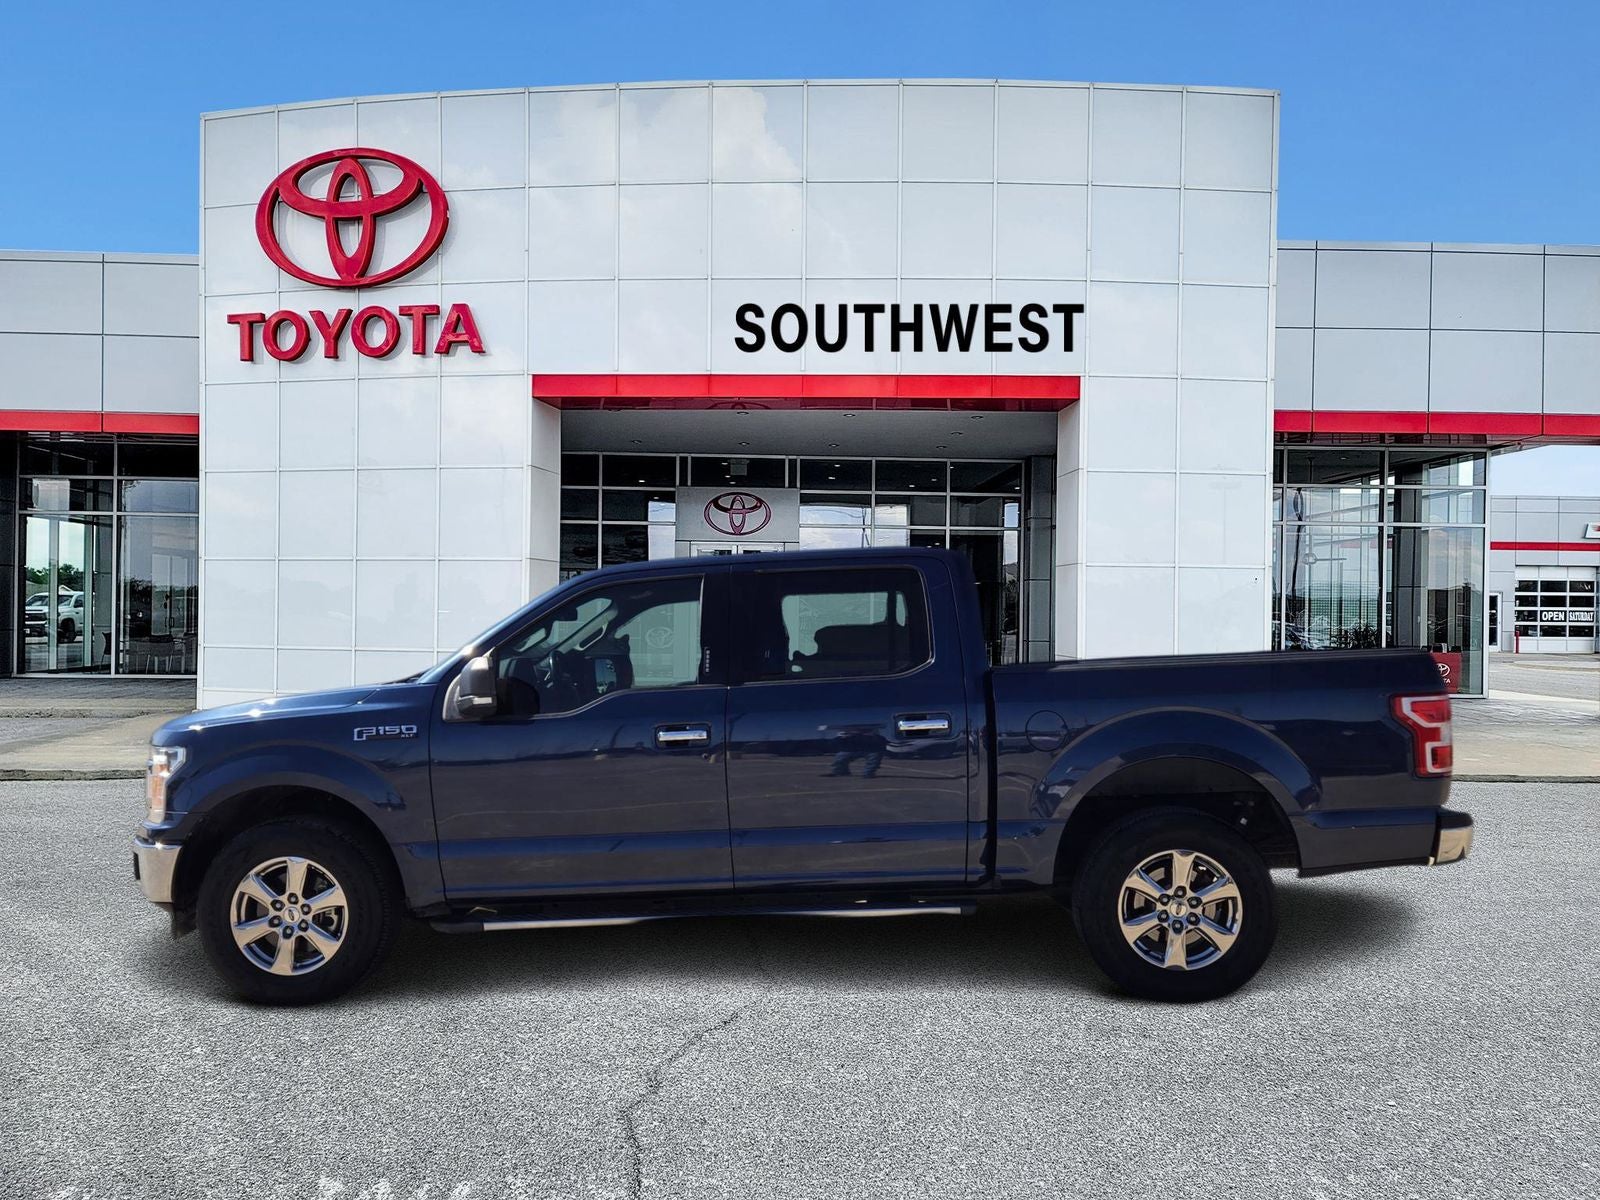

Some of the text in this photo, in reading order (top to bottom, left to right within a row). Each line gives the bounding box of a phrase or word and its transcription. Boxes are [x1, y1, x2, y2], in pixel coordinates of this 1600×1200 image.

[227, 303, 486, 362] TOYOTA
[734, 303, 1085, 353] SOUTHWEST
[1541, 611, 1594, 621] OPEN SATURDAY
